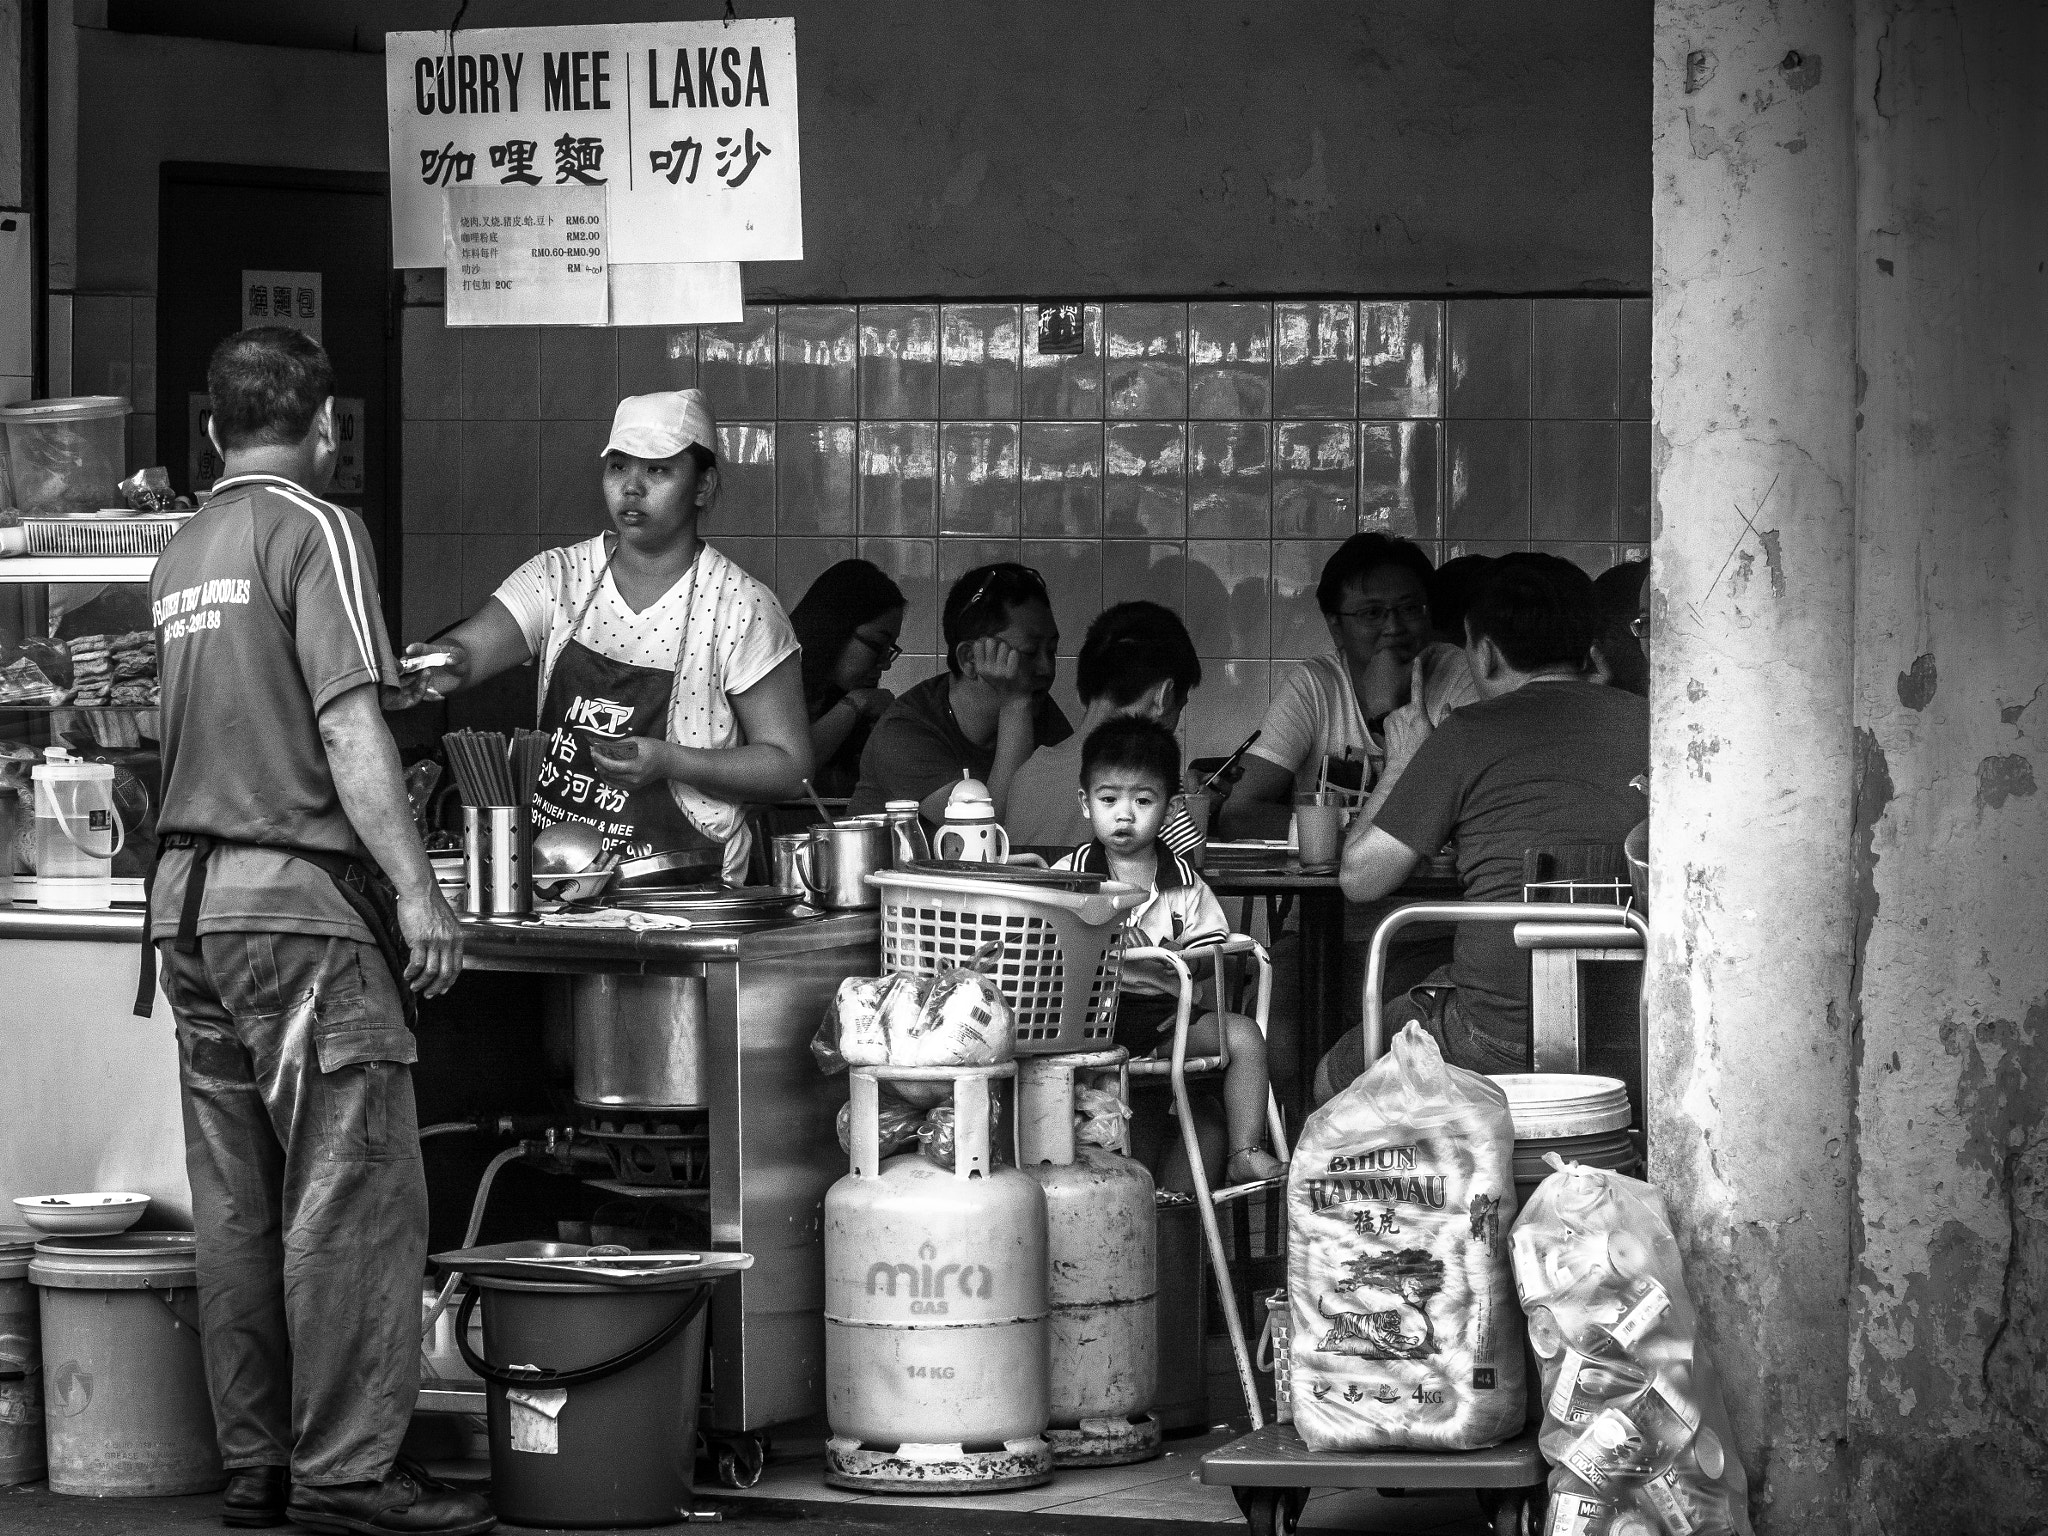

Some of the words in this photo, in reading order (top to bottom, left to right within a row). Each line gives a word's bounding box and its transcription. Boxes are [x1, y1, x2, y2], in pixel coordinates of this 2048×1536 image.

[415, 52, 524, 115] CURRY
[543, 51, 611, 112] MEE
[649, 46, 769, 109] LAKSA
[420, 132, 608, 187] 咖哩麵
[650, 128, 771, 187] 叻沙
[565, 215, 600, 225] RM6.00
[566, 231, 600, 241] RM2.00
[531, 247, 601, 258] RM0.60-RM0.90
[567, 263, 581, 273] RM
[538, 757, 630, 813] 沙河粉
[542, 799, 566, 820] KUEH
[597, 820, 606, 833] &
[608, 823, 634, 837] MEE
[1327, 1145, 1418, 1174] BIHUN
[1306, 1174, 1448, 1215] HARIMAU
[1353, 1207, 1400, 1236] 猛虎
[866, 1242, 993, 1299] mira
[909, 1300, 949, 1315] GAS
[907, 1366, 927, 1379] 14
[930, 1366, 955, 1379] KG
